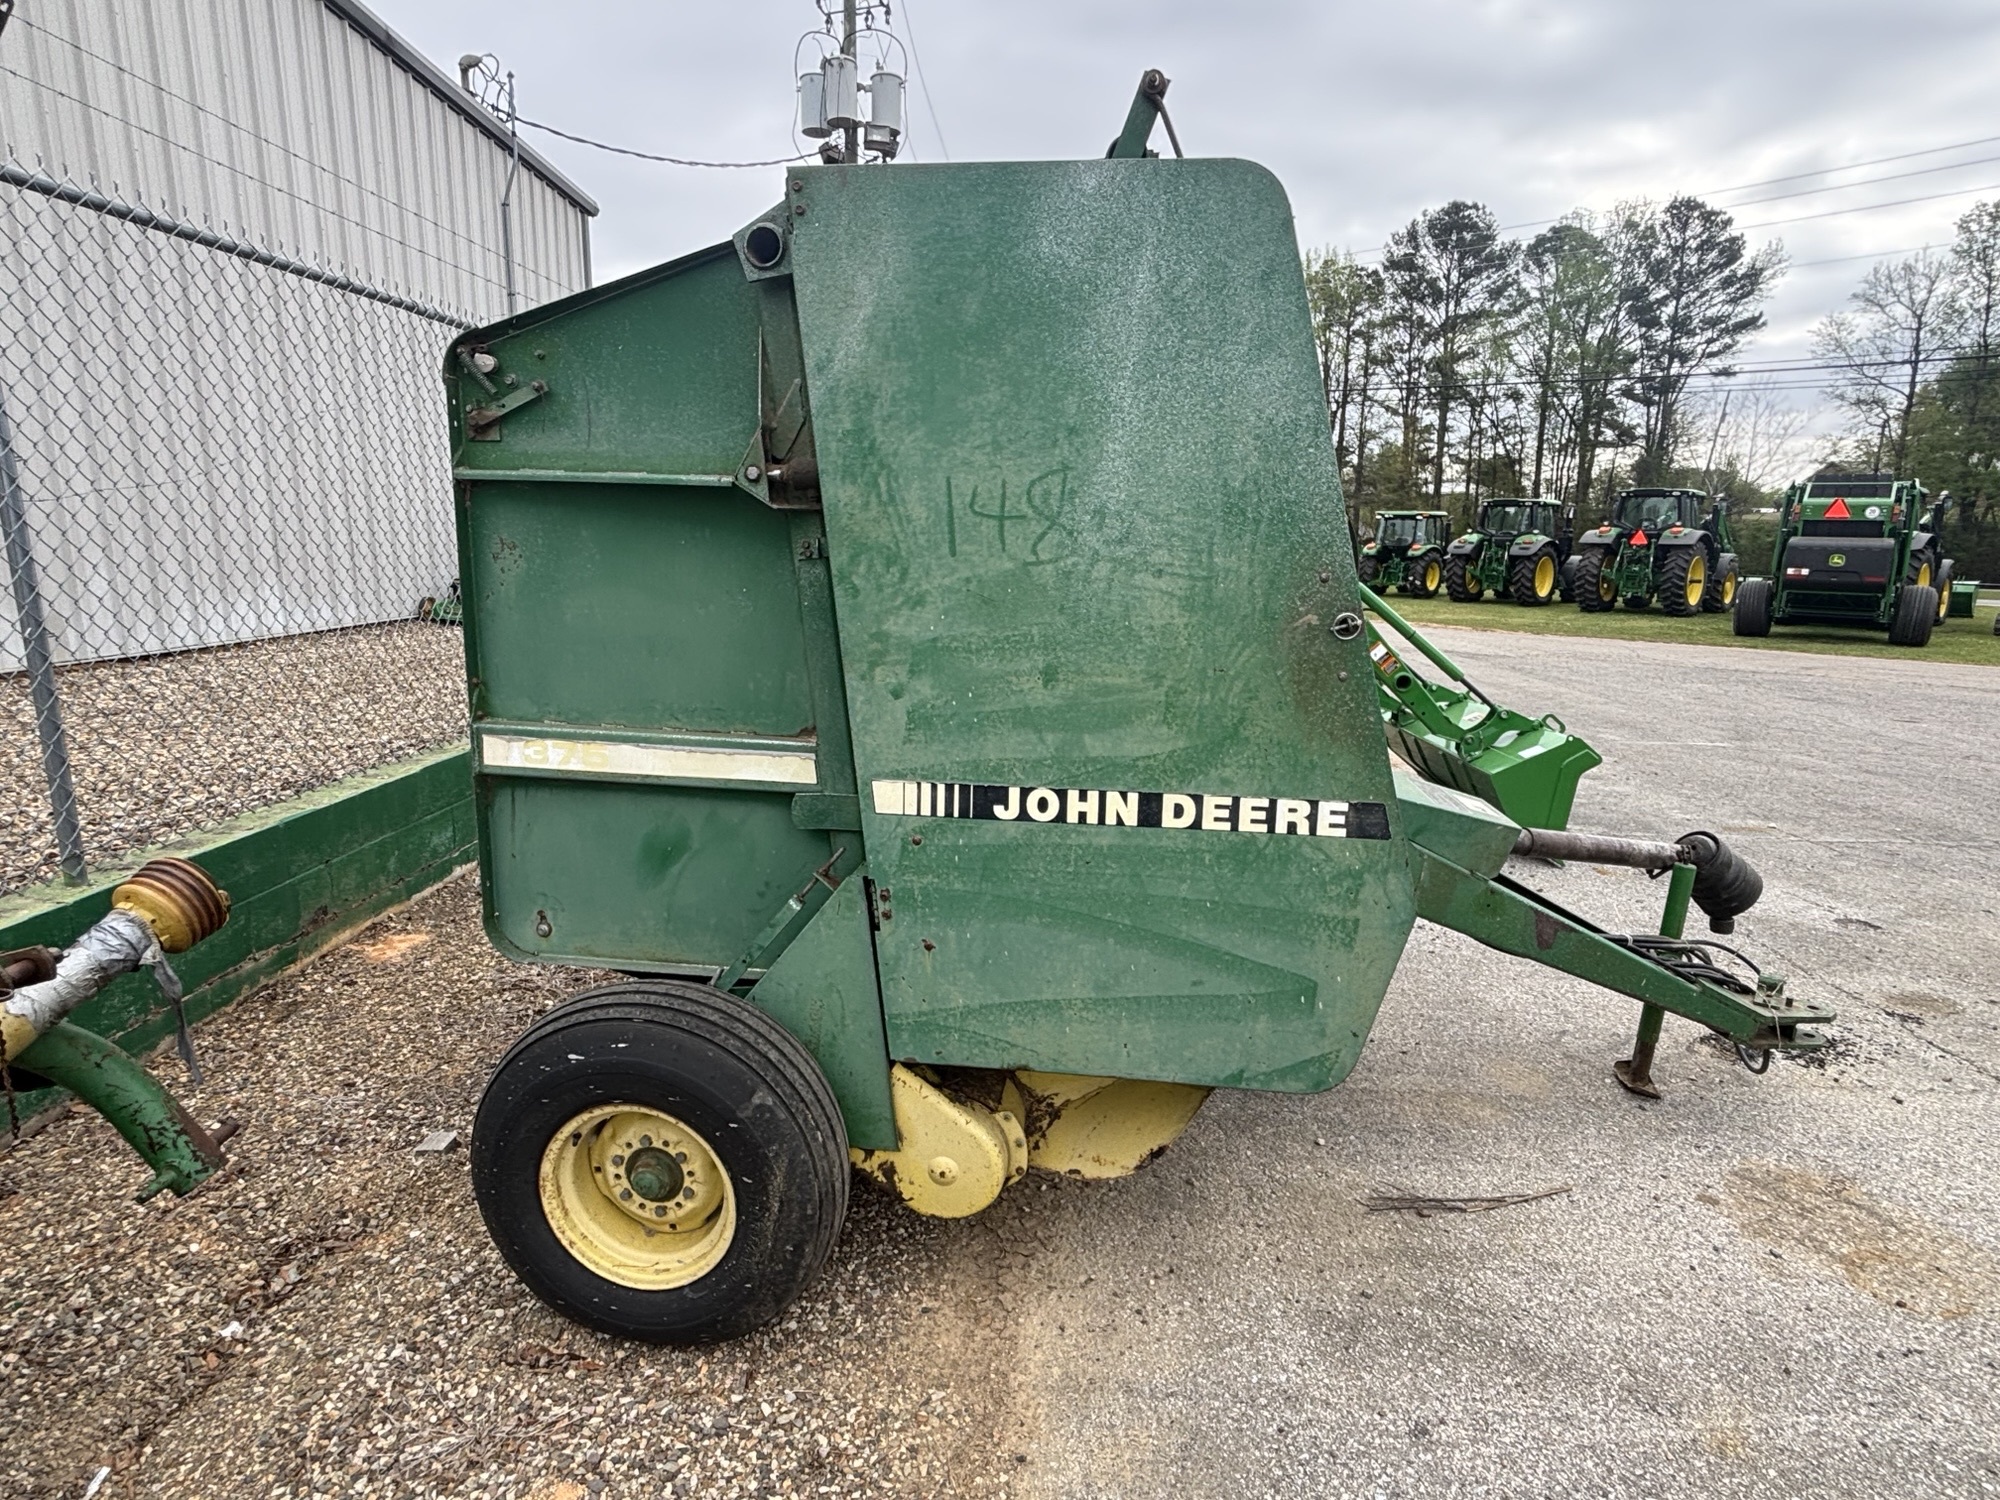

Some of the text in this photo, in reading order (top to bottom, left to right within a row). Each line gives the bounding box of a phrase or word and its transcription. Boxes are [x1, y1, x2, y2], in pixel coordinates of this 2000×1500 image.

[946, 464, 1073, 566] 148
[523, 740, 609, 768] 375
[993, 786, 1349, 838] JOHN DEERE
